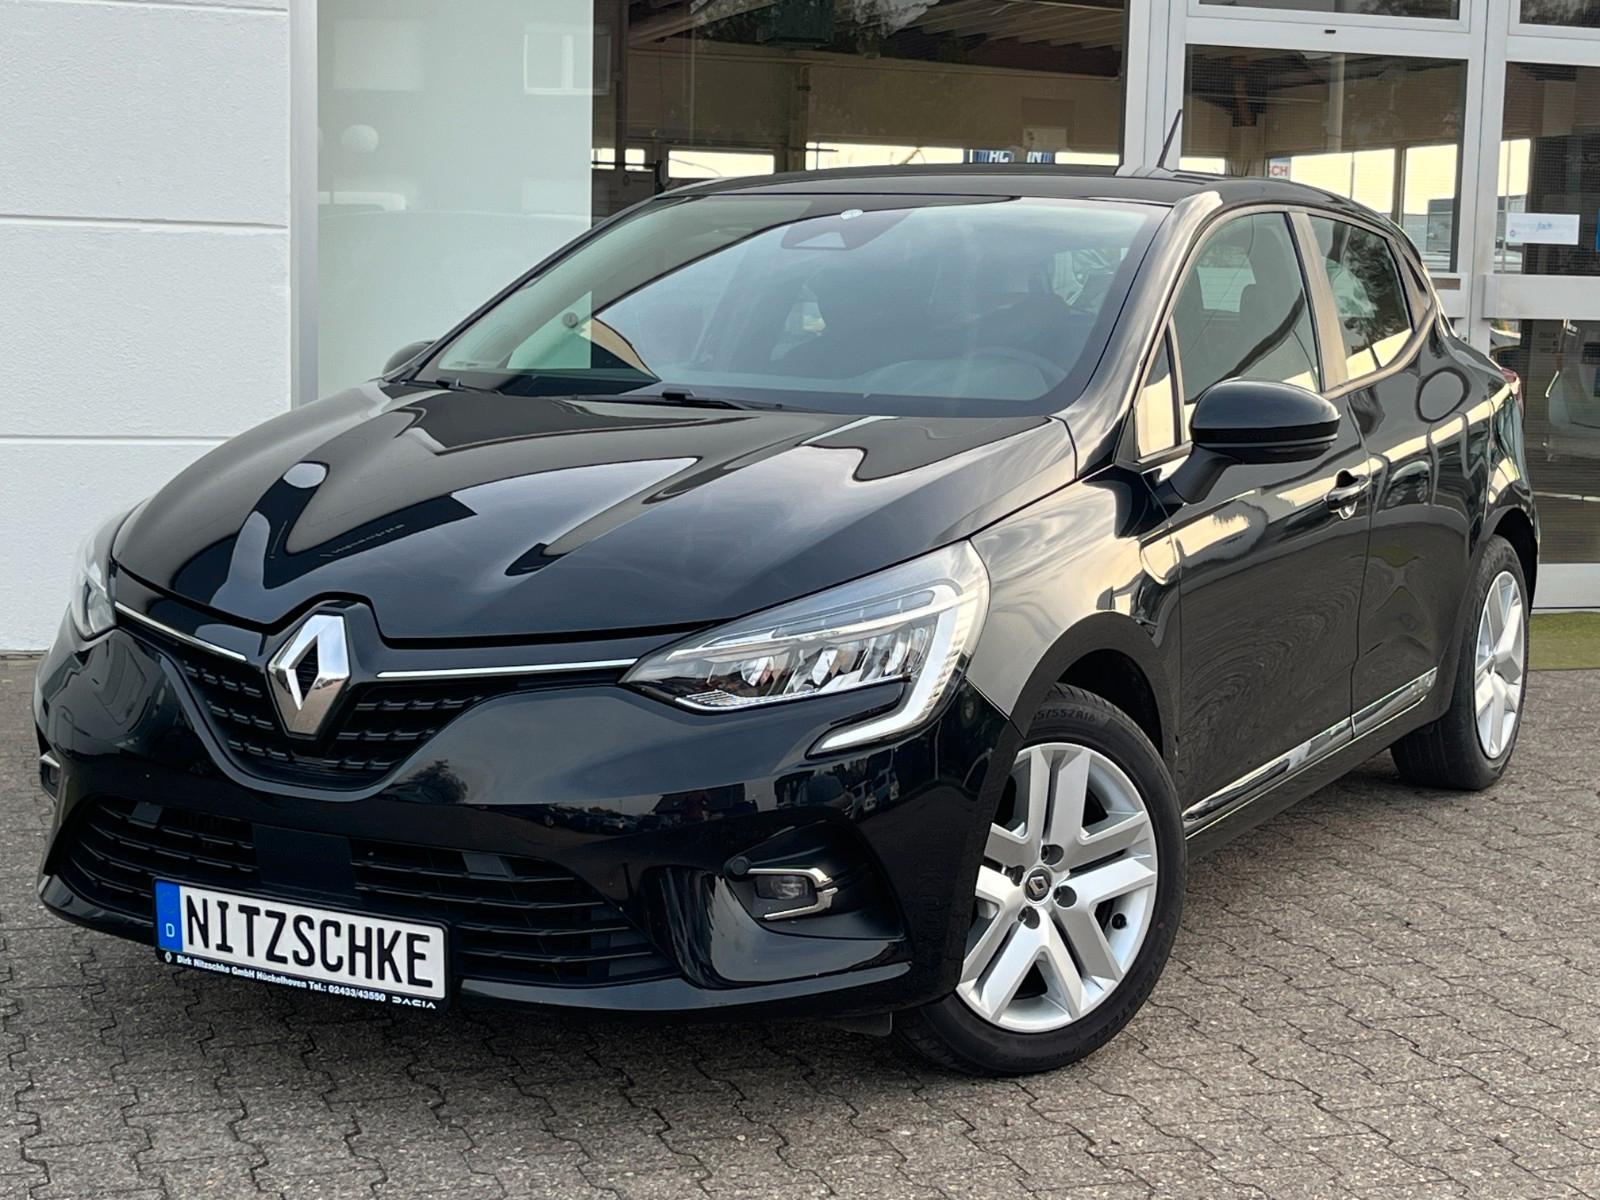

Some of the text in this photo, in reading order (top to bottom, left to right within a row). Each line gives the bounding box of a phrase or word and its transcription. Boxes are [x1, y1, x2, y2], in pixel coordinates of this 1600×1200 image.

[165, 923, 175, 937] D
[186, 895, 433, 988] NITZSCHKE
[176, 955, 193, 966] Dirk
[193, 958, 230, 974] Nitzschke
[231, 966, 255, 979] GmbH
[328, 984, 386, 1002] 02433/43550
[392, 996, 436, 1010] DACIA
